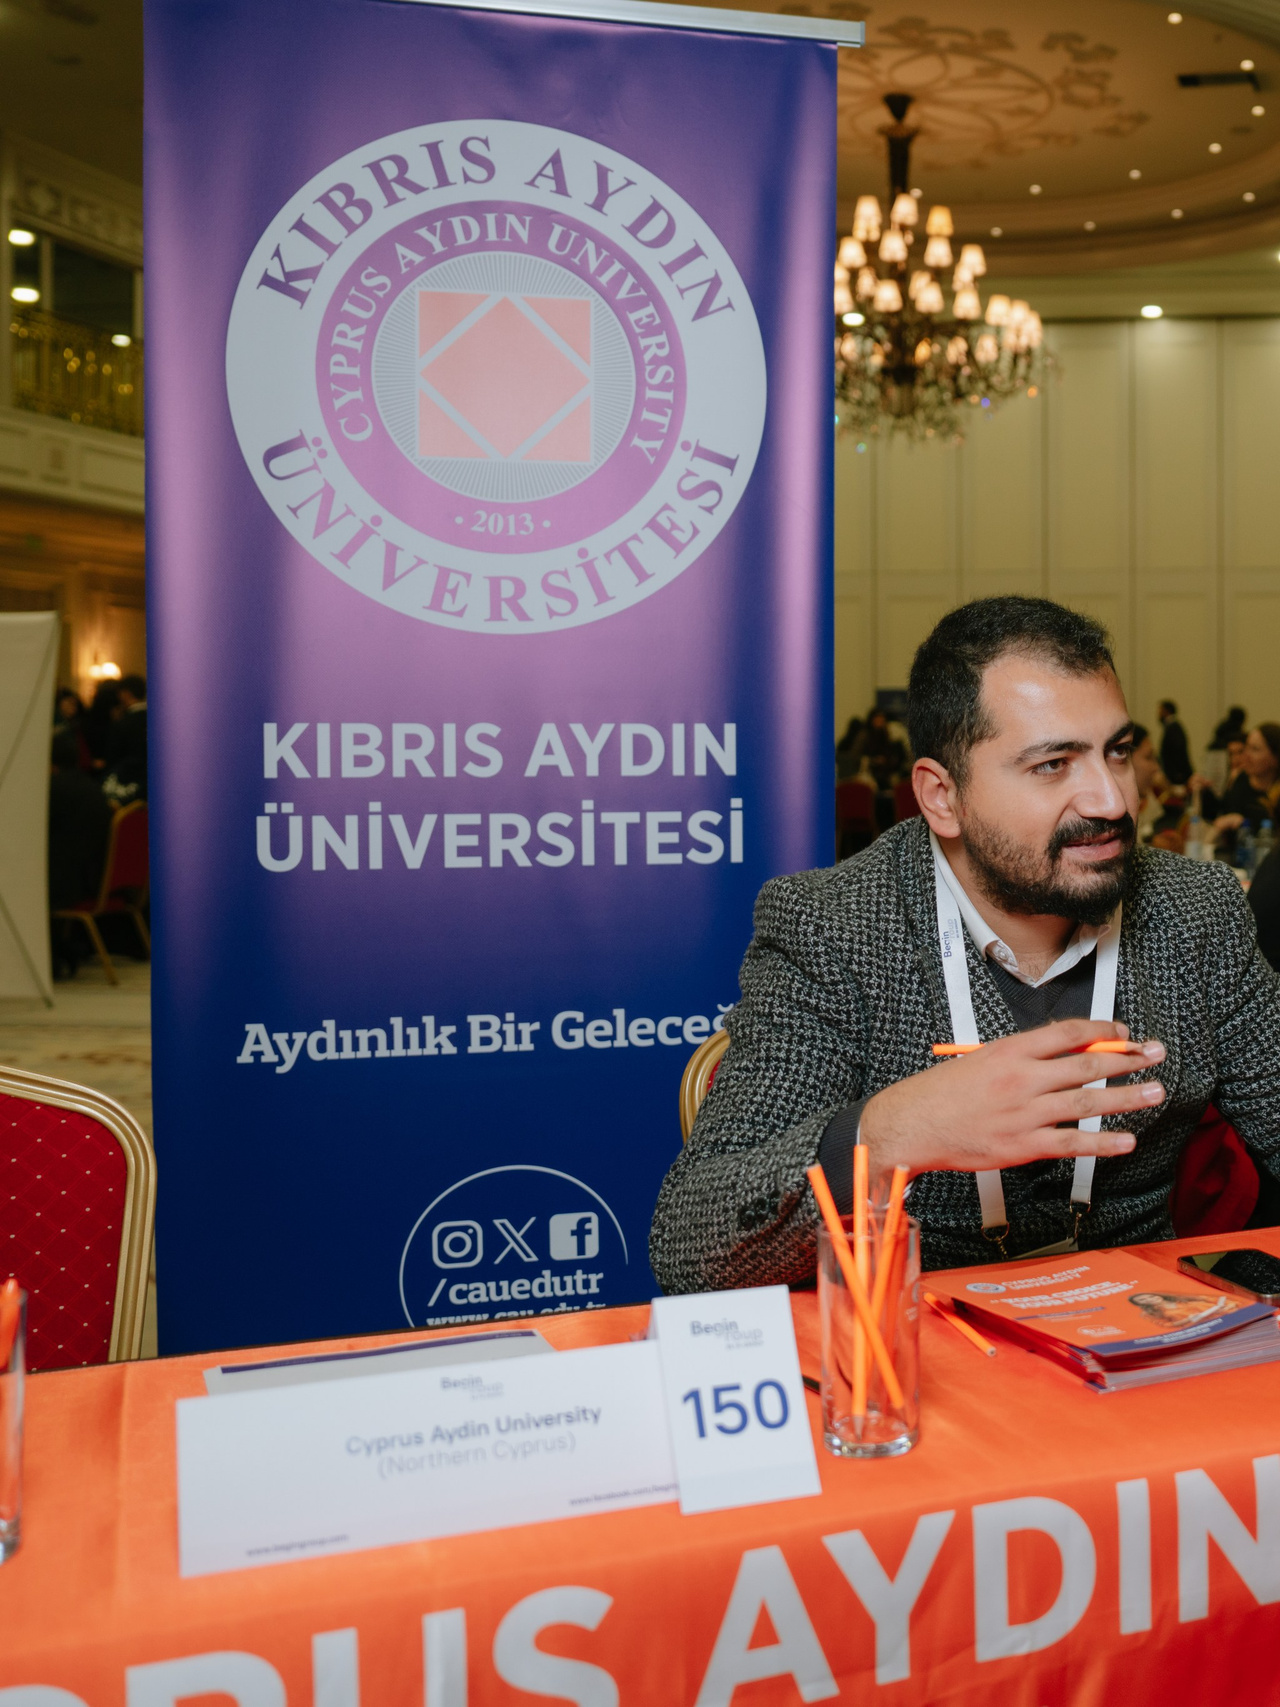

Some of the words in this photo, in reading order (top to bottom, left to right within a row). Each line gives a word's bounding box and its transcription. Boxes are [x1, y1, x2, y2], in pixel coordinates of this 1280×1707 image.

[256, 136, 496, 310] KIBRIS
[525, 148, 735, 323] AYDIN
[330, 266, 392, 441] CYPRUS
[393, 213, 533, 273] AYDIN
[547, 223, 675, 464] UNIVERSITY
[262, 429, 739, 622] ÜNİVERSİTESİ
[469, 509, 535, 536] 2013
[262, 722, 504, 779] KIBRIS
[523, 722, 738, 778] AYDIN
[256, 797, 744, 873] ÜNİVERSİTESİ
[236, 1014, 457, 1074] Aydınlık
[467, 1013, 540, 1054] Bir
[427, 1269, 604, 1307] /cauedutr
[345, 1429, 424, 1456] Cyprus
[430, 1419, 490, 1445] Aydin
[495, 1403, 602, 1435] University
[682, 1378, 791, 1439] 150
[377, 1445, 487, 1480] (Northern
[492, 1430, 577, 1462] Cyprus)
